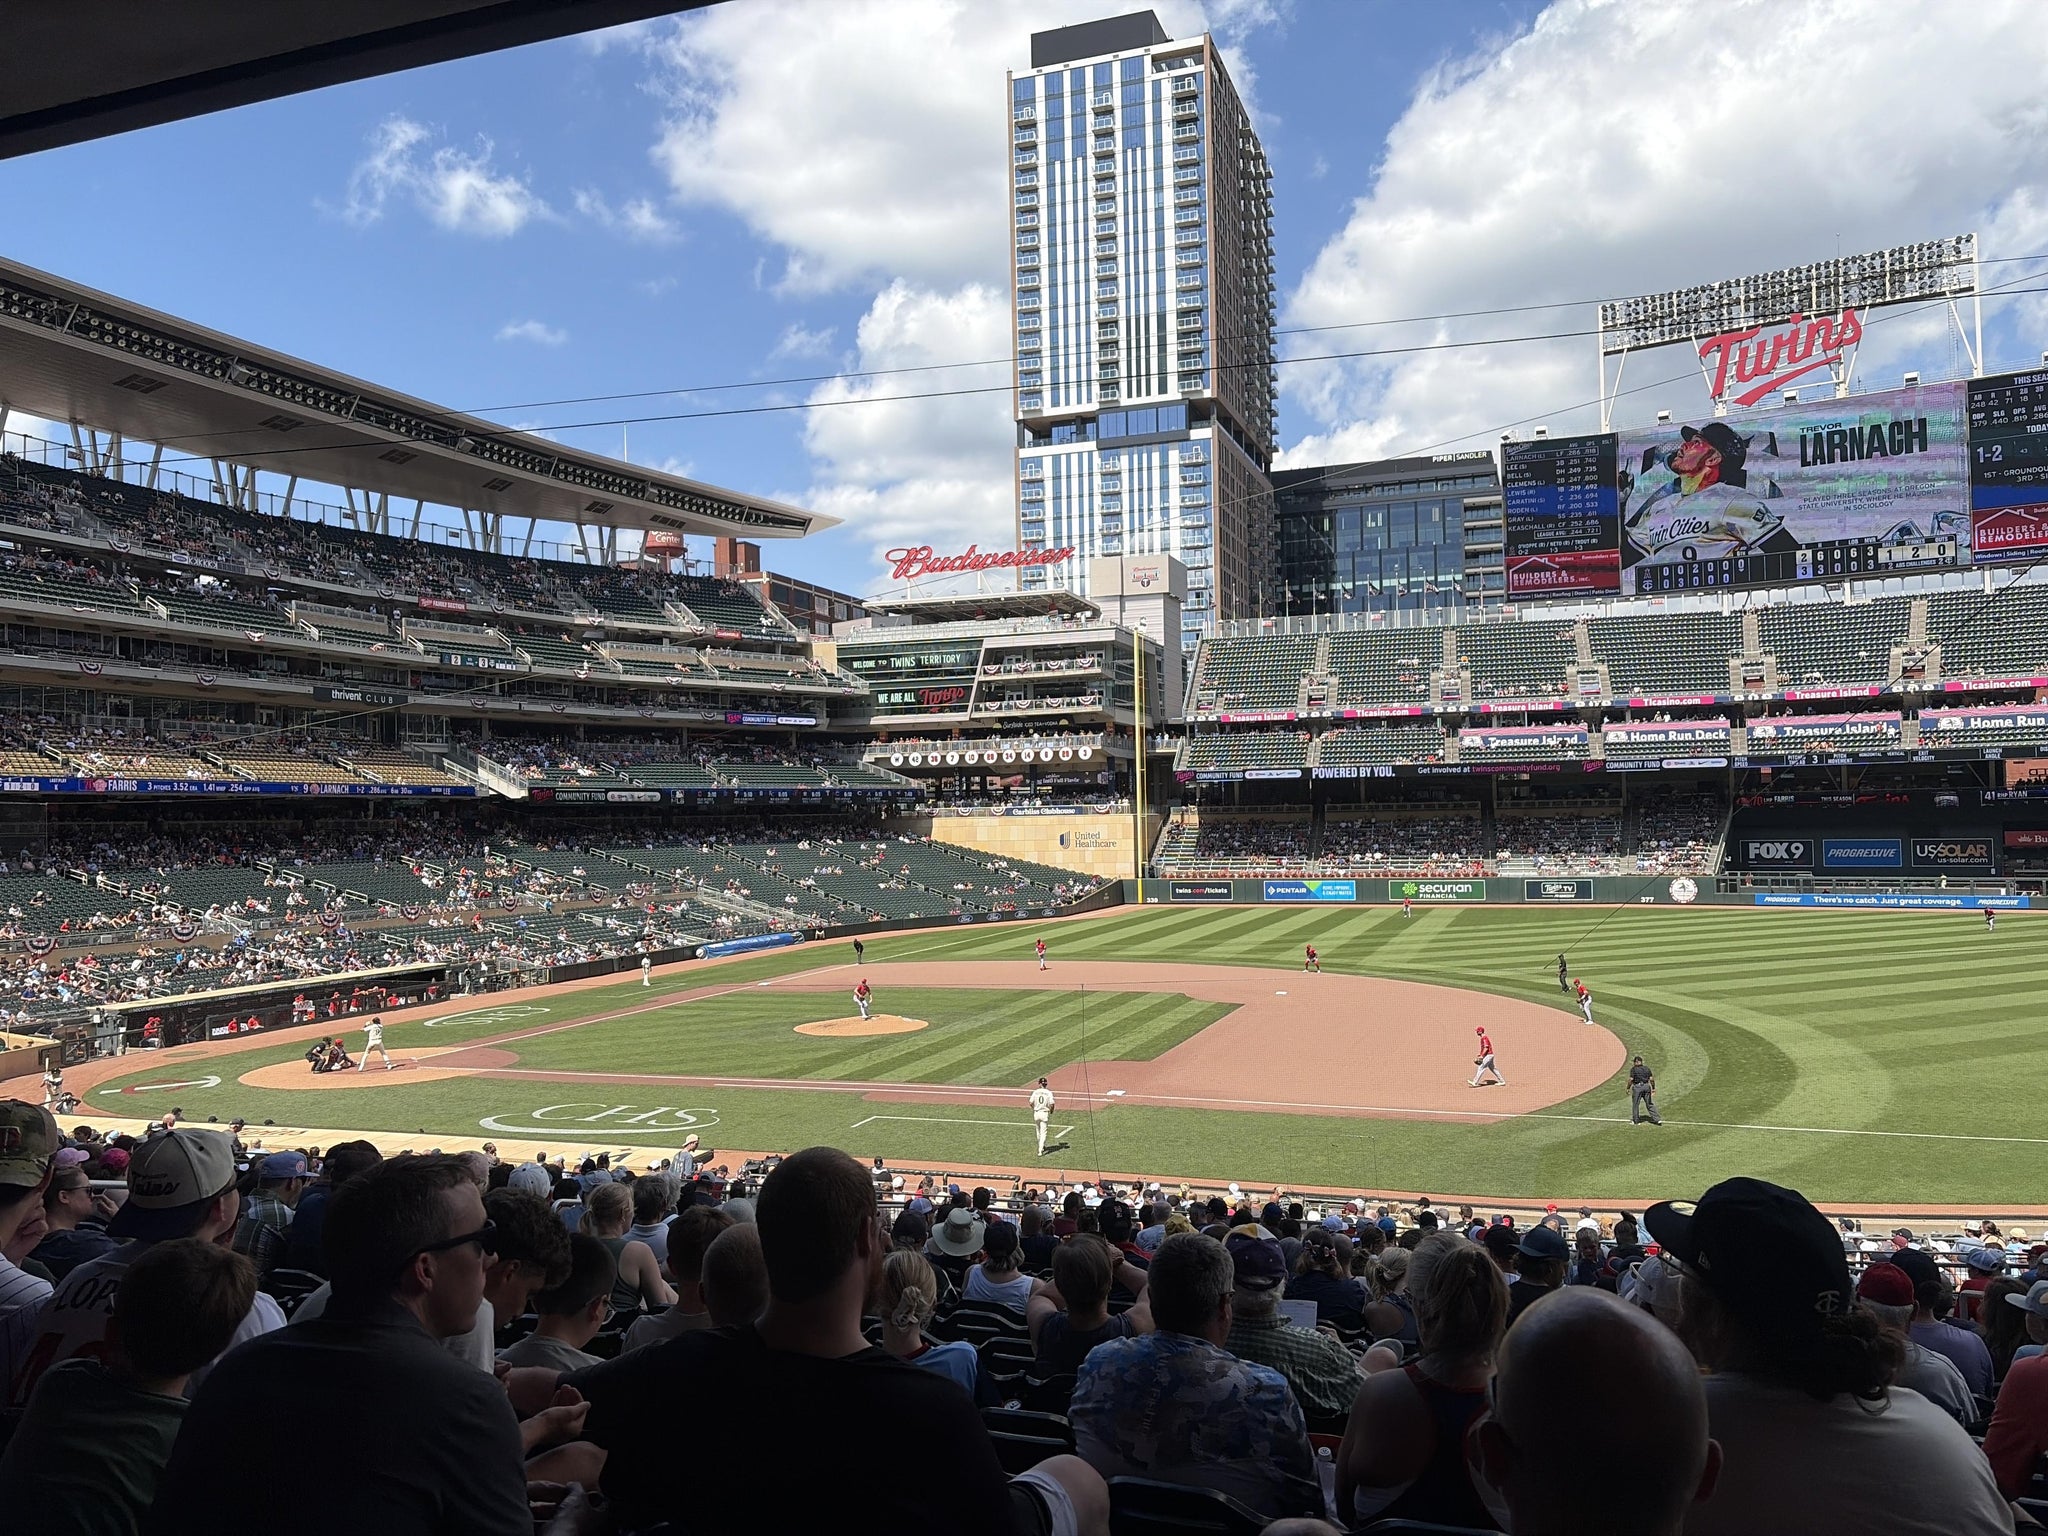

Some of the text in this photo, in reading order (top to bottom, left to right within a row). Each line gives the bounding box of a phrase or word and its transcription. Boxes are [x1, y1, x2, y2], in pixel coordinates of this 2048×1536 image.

[1699, 308, 1862, 402] Twins
[1970, 401, 1986, 409] 248
[2033, 404, 2047, 412] AVG
[1800, 422, 1842, 434] TREVOR
[1800, 417, 1928, 468] LARNACH
[1432, 451, 1487, 463] PIPER SANDLER
[1977, 444, 2003, 463] 1-2
[1803, 495, 1831, 503] PLAYED
[1833, 492, 1856, 500] THREE
[1857, 488, 1892, 498] SEASONS
[1904, 482, 1936, 492] OREGON
[1507, 498, 1537, 506] CARATINI
[1798, 503, 1820, 511] STATE
[1865, 494, 1892, 504] WHERE
[1893, 492, 1904, 500] HE
[1905, 488, 1942, 499] MAJORED
[1853, 500, 1894, 511] SOCIOLOGY
[1669, 516, 1710, 539] Cities
[1980, 524, 2036, 537] BUILDERS
[885, 543, 1076, 580] Budweiser
[1663, 544, 1946, 576] 0 0 2 0 0 0 2 6 1 2 0
[1513, 571, 1557, 580] BUILDERS
[454, 656, 458, 664] 2
[852, 660, 876, 669] WELCOME
[890, 656, 916, 668] TWINS
[920, 653, 961, 665] TERRITORY
[331, 689, 393, 704] thrivent CLUB
[878, 687, 966, 705] WE ARE ALL Twins
[1795, 687, 1869, 700] Treasure Island
[1489, 702, 1554, 712] Treasure Island
[1229, 712, 1287, 722] Treasure Island
[1970, 715, 2046, 729] Home Run
[1630, 729, 1727, 742] Home Run Deck
[1783, 722, 1887, 737] Treasure Island
[1488, 737, 1539, 747] Treasure
[968, 753, 975, 761] 10
[1812, 755, 1818, 763] 3
[1312, 766, 1358, 779] POWERED
[1359, 766, 1372, 778] BY
[1373, 765, 1396, 778] YOU.
[1417, 766, 1431, 774] Get
[1432, 765, 1462, 774] involved
[1472, 763, 1561, 774] twinscommunityfund.org
[1582, 760, 1604, 773] Twins
[1606, 761, 1643, 770] COMMUNITY
[1644, 760, 1660, 769] FUND
[1175, 771, 1195, 783] Twins
[1196, 771, 1228, 780] COMMUNITY
[1229, 771, 1244, 779] FUND
[108, 780, 138, 791] FARRIS
[147, 782, 153, 790] 3
[172, 782, 189, 791] 3.52
[203, 783, 216, 792] 1.41
[228, 783, 243, 792] .254
[303, 784, 309, 793] 9
[320, 784, 349, 794] LARNACH
[356, 786, 365, 794] 1-2
[555, 791, 587, 801] COMMUNITY
[589, 791, 605, 801] FUND
[1984, 791, 1996, 800] 41
[2008, 790, 2028, 798] RYAN
[1040, 807, 1076, 815] Clubhouse
[1074, 831, 1101, 840] United
[1075, 839, 1117, 848] Healthcare
[1748, 842, 1804, 859] FOX 9
[1827, 848, 1898, 858] PROGRESSIVE
[1937, 856, 1989, 864] us-solar.com
[1419, 884, 1472, 893] securian
[1813, 896, 1842, 904] There's
[1855, 896, 1879, 905] catch.
[1881, 896, 1898, 905] Just
[1899, 897, 1922, 906] great
[1923, 898, 1964, 907] coverage.
[1977, 898, 2020, 906] PROGRESSIVE
[1038, 1095, 1045, 1105] 0
[531, 1103, 718, 1126] CHS
